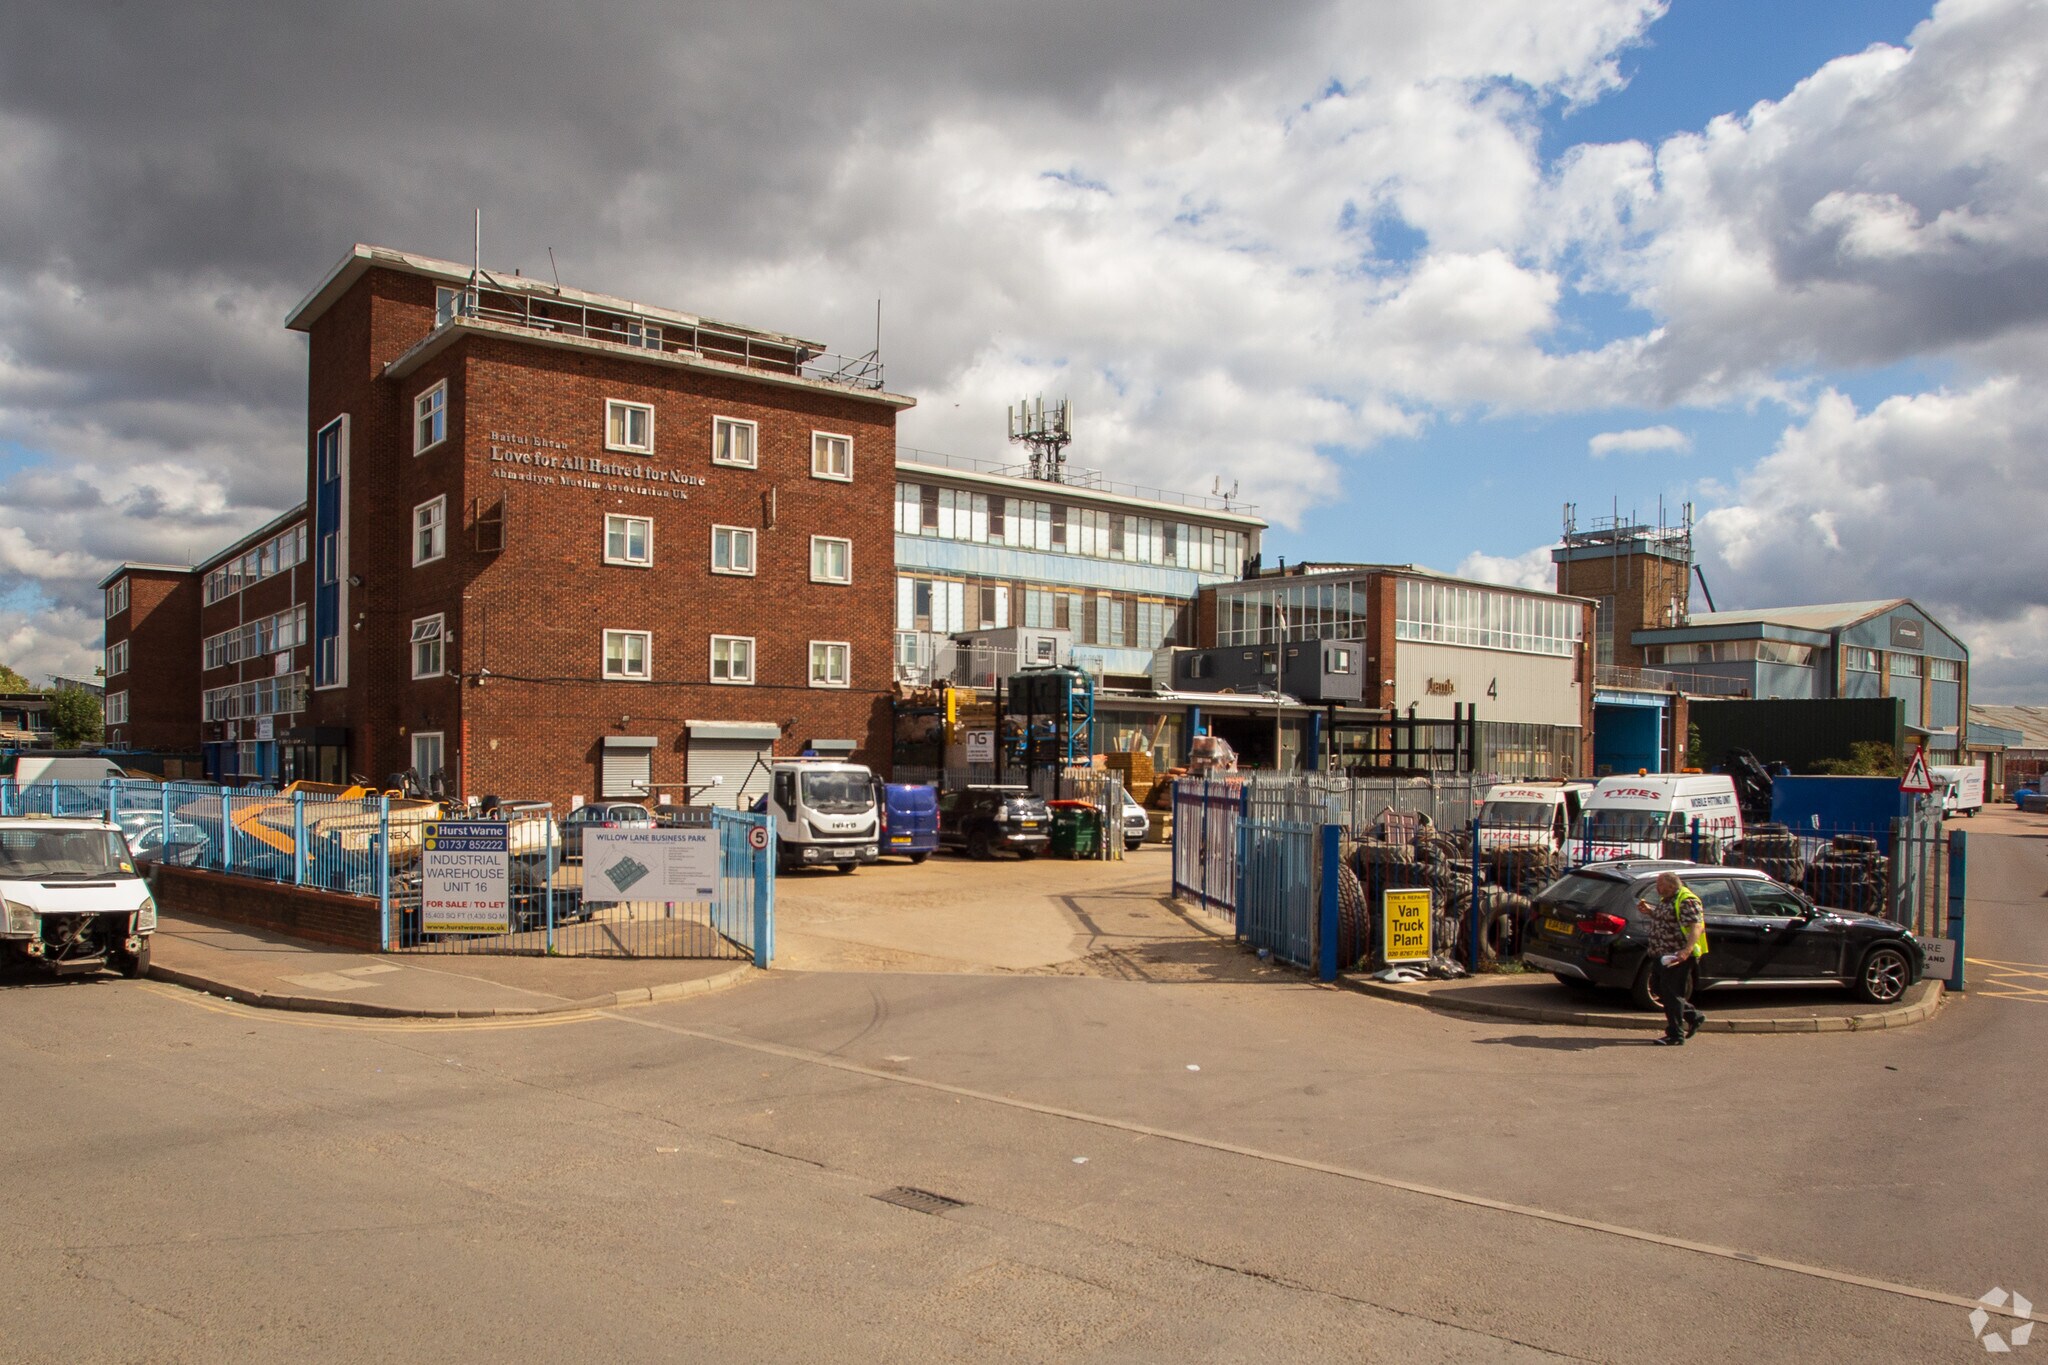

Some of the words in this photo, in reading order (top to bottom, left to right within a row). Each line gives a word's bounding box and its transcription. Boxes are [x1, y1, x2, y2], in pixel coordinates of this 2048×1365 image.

[491, 431, 528, 445] Baitul
[532, 436, 568, 450] Ehsan
[491, 445, 532, 465] Love
[532, 452, 558, 469] for
[561, 454, 585, 472] All
[587, 457, 642, 479] Hatred
[645, 465, 668, 482] for
[669, 468, 706, 487] None
[491, 468, 555, 486] Ahmadiyya
[559, 474, 602, 490] Muslim
[604, 480, 670, 498] Association
[672, 488, 689, 500] UK
[1486, 677, 1498, 701] 4
[1498, 790, 1545, 799] TYRES
[1603, 788, 1661, 800] TYRES
[439, 826, 468, 836] Hurst
[470, 826, 503, 836] Warne
[596, 833, 628, 842] WILLOW
[630, 834, 649, 842] LANE
[651, 834, 686, 842] BUSINESS
[687, 835, 706, 843] PARK
[756, 831, 764, 844] 5
[1482, 832, 1532, 841] TYRES
[439, 840, 466, 849] 01737
[469, 840, 503, 850] 852222
[430, 855, 501, 865] INDUSTRIAL
[427, 868, 504, 879] WAREHOUSE
[443, 882, 471, 892] UNIT
[476, 882, 487, 892] 16
[487, 912, 498, 920] SQ
[1398, 905, 1419, 918] Van
[426, 924, 505, 932] www.hurstwarne.co.uk
[1392, 919, 1424, 931] Truck
[1394, 934, 1423, 946] Plant
[1928, 955, 1945, 963] AND
